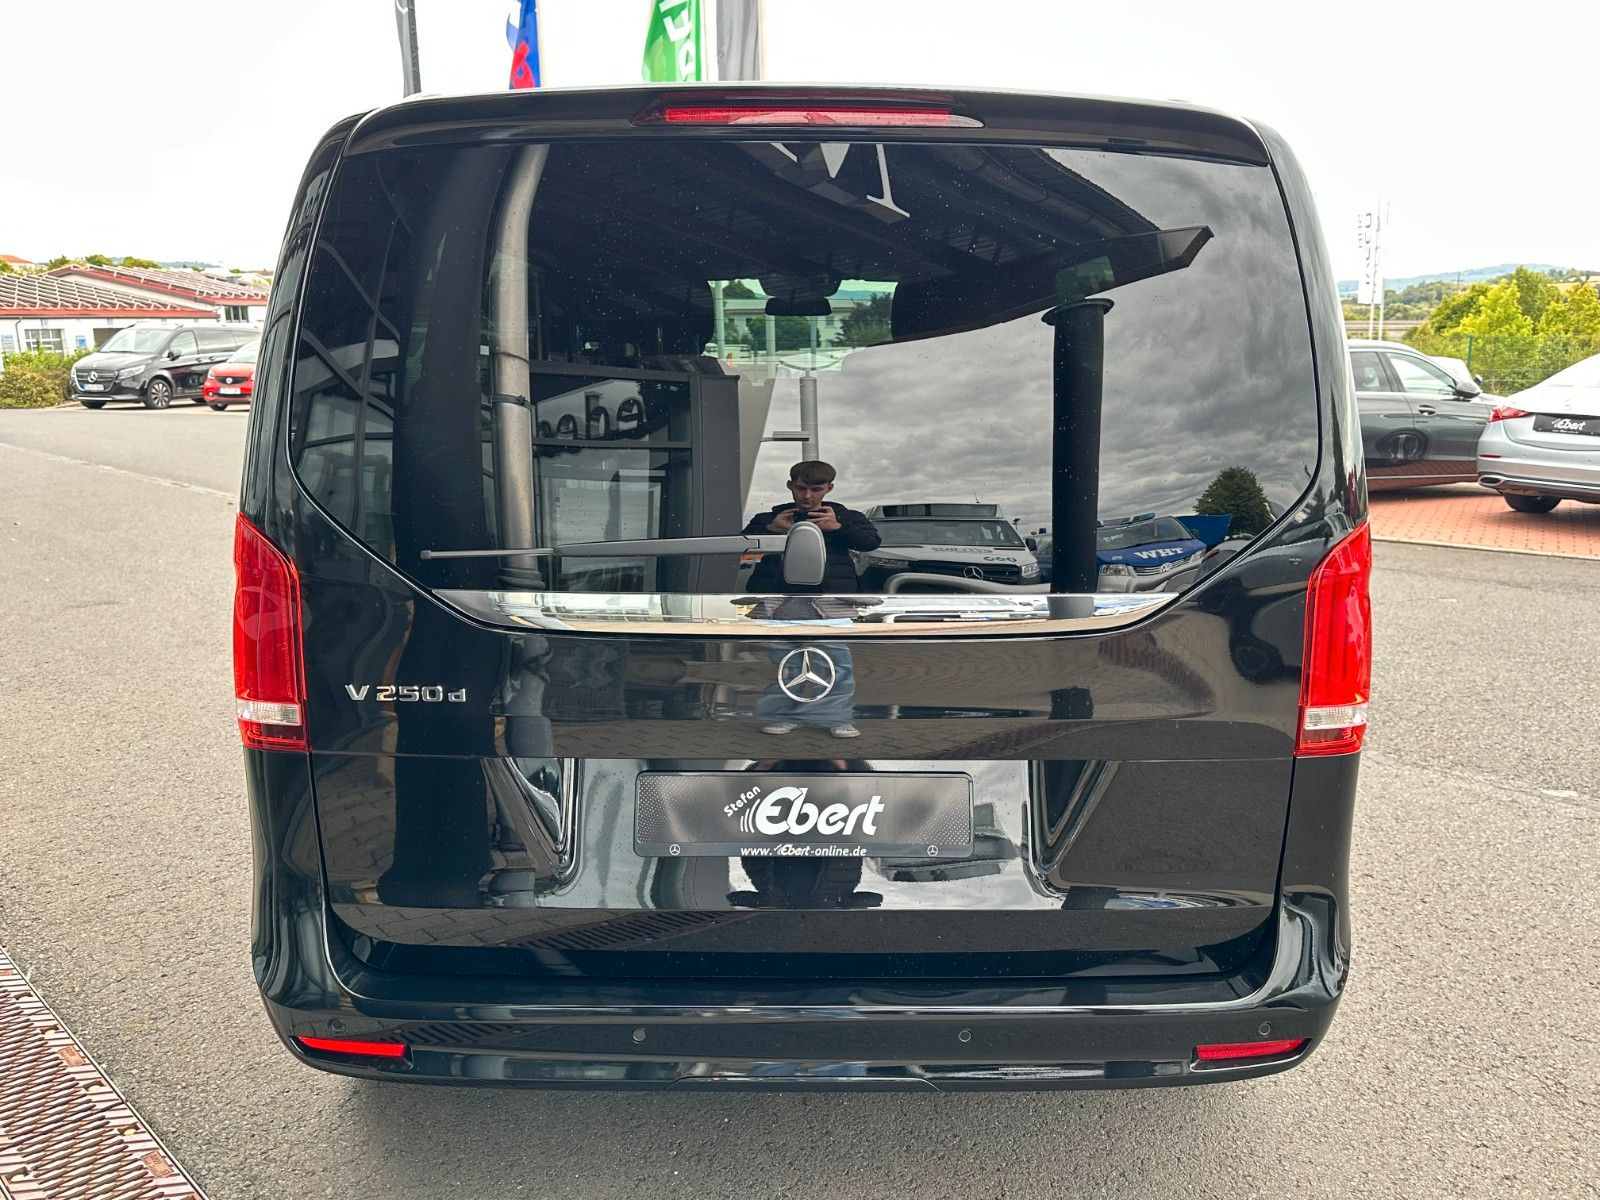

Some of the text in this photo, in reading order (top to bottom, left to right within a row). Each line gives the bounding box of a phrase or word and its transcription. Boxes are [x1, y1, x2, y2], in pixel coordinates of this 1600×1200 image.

[345, 684, 370, 701] V
[723, 786, 761, 817] Stefan
[755, 786, 885, 836] Ebert
[741, 843, 867, 856] www.Ebert-online.de
